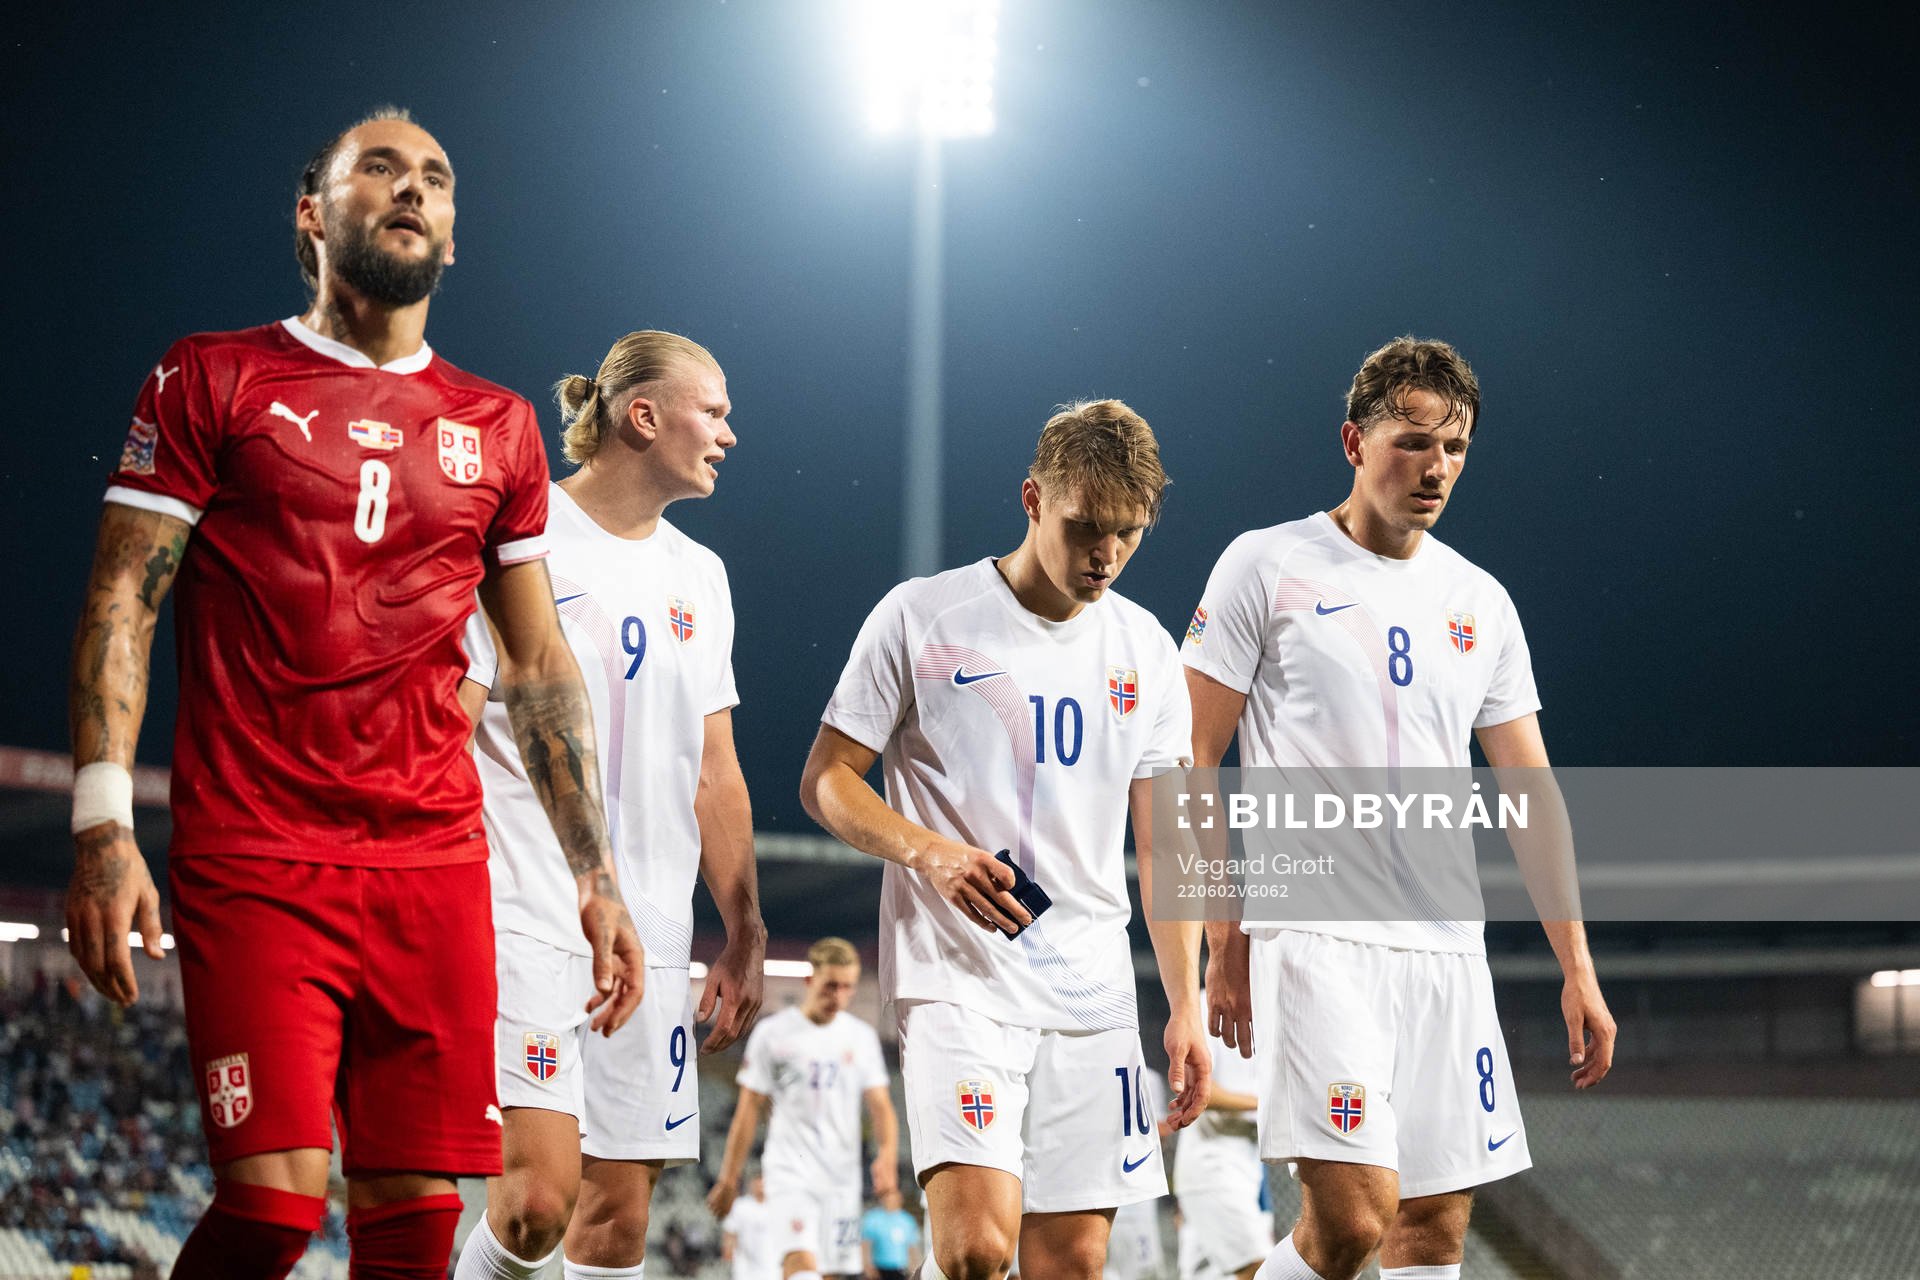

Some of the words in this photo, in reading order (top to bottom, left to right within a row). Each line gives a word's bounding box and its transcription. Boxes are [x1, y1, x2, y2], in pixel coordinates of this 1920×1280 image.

[353, 459, 390, 543] 8
[621, 616, 647, 680] 9
[1388, 626, 1413, 687] 8
[1029, 695, 1083, 766] 10
[669, 1026, 687, 1092] 9
[1476, 1047, 1495, 1113] 8
